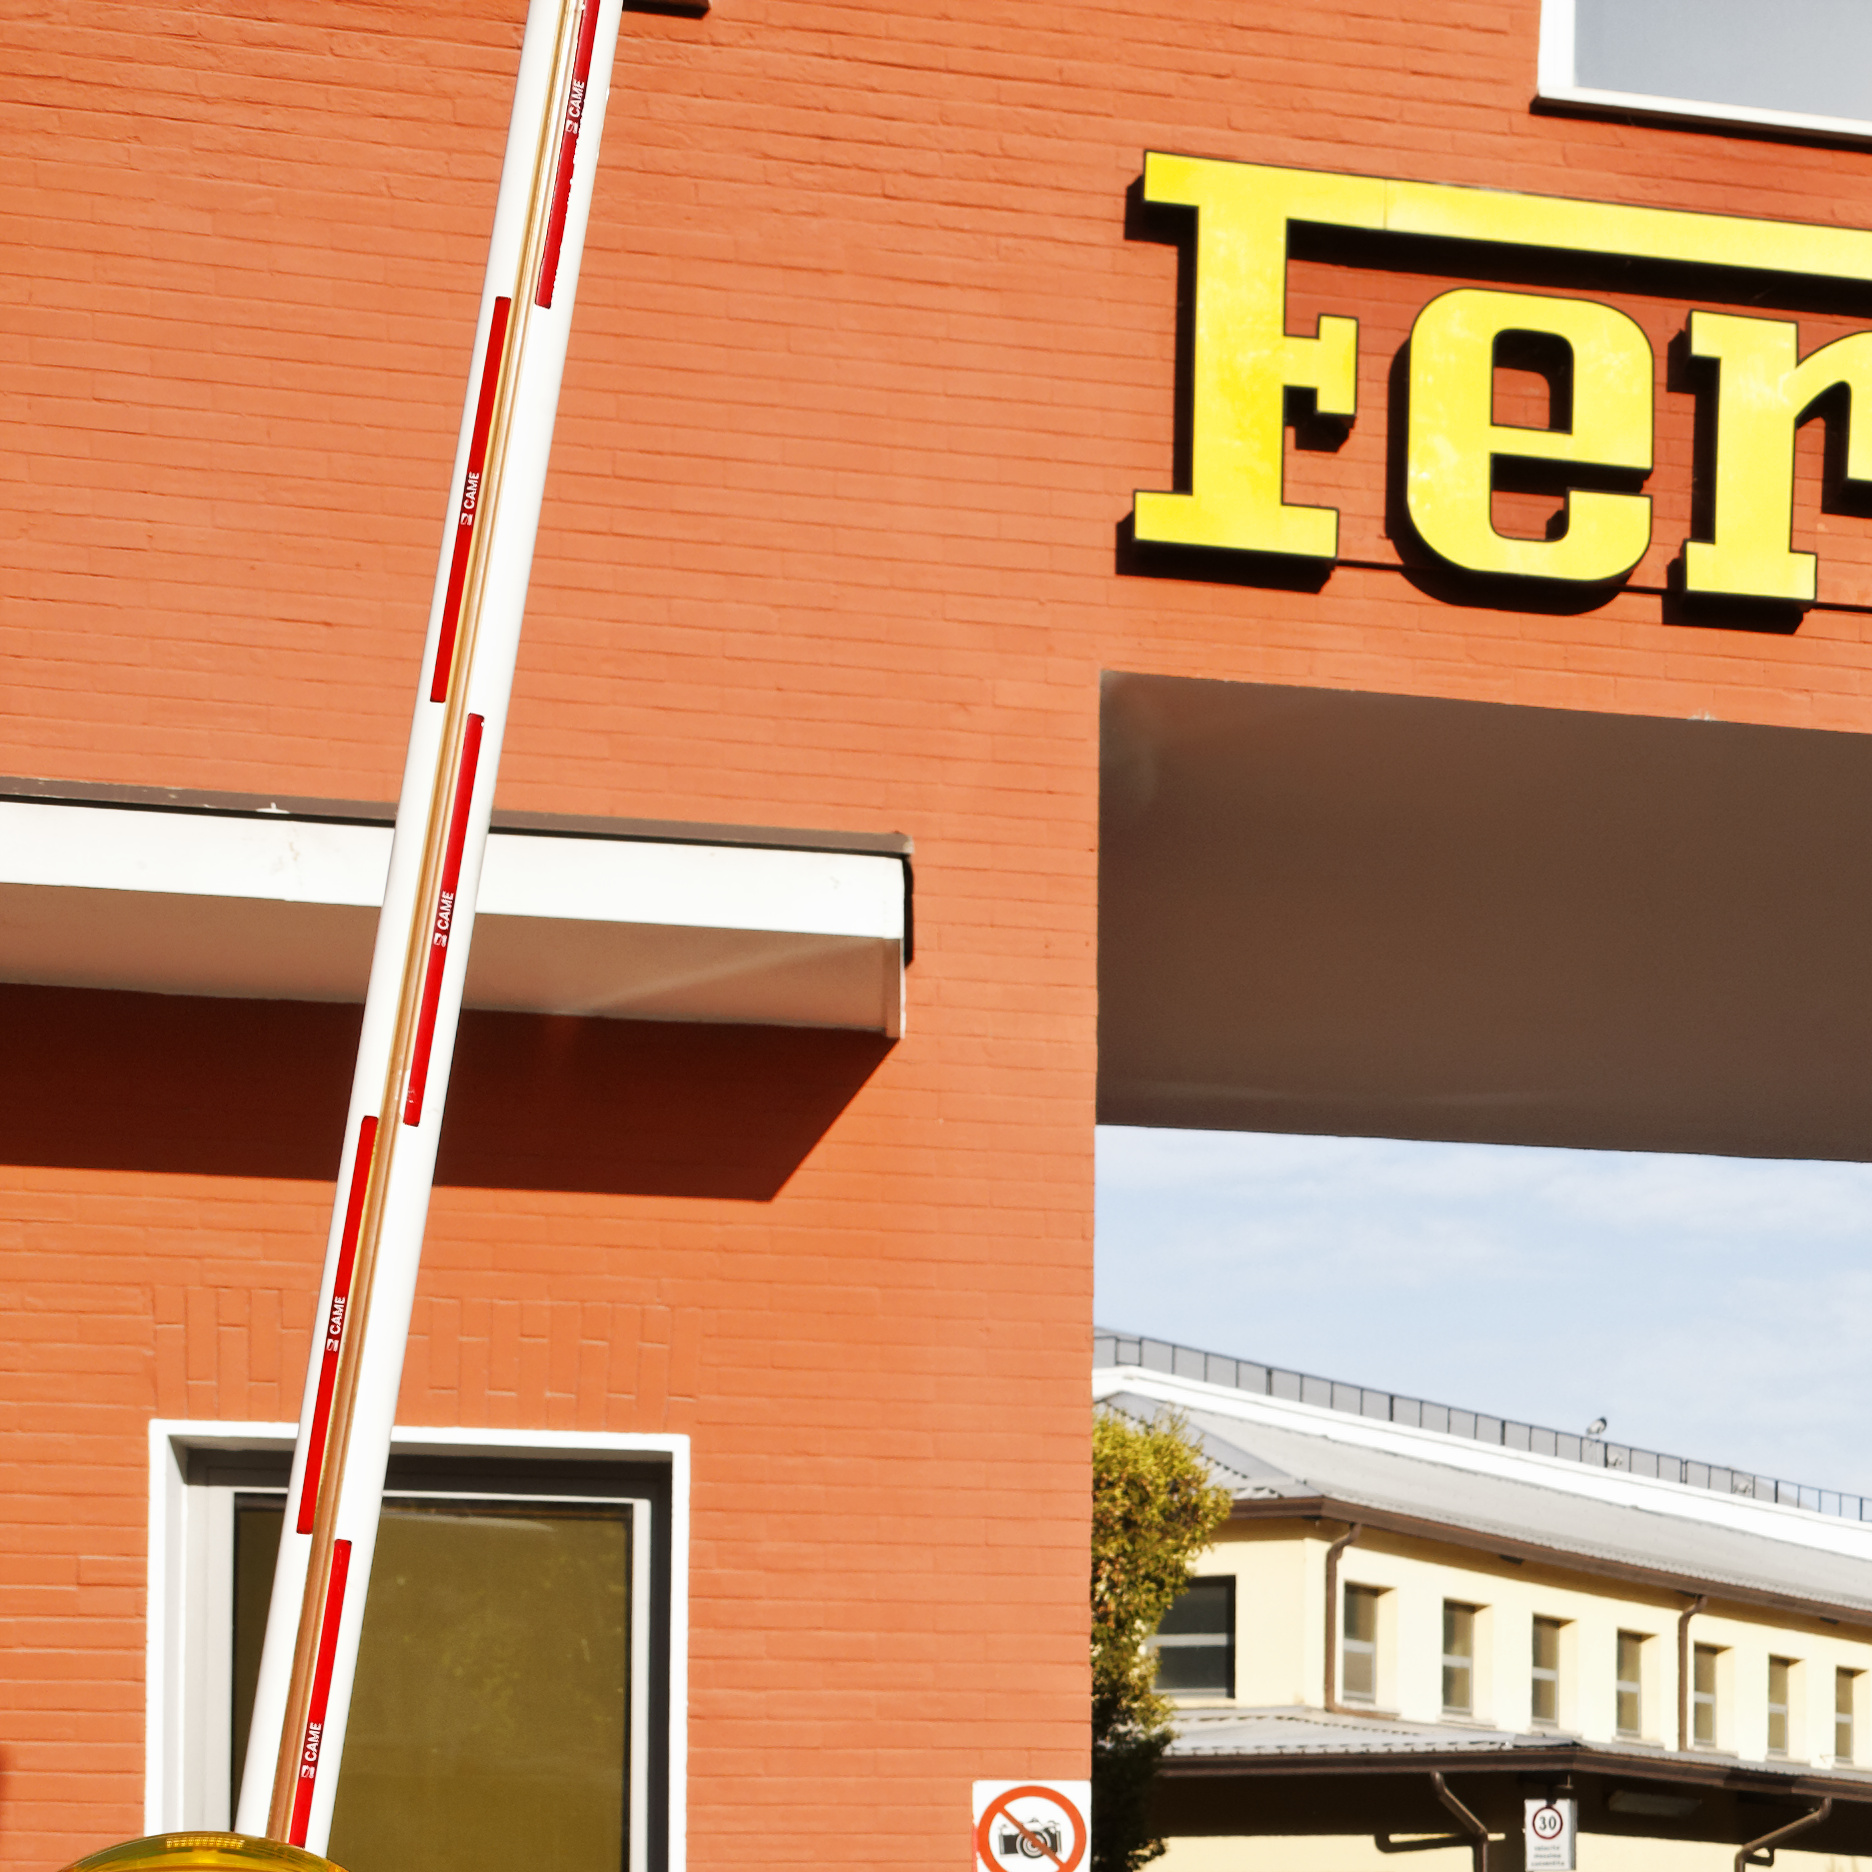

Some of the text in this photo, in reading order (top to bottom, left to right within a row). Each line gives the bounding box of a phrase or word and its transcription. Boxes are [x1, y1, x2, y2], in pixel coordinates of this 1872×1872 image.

[568, 80, 586, 118] CAME
[464, 471, 480, 509] CAME
[437, 891, 454, 931] CAME
[329, 1296, 346, 1335] CAME
[304, 1722, 322, 1762] CAME
[1538, 1816, 1557, 1831] 30
